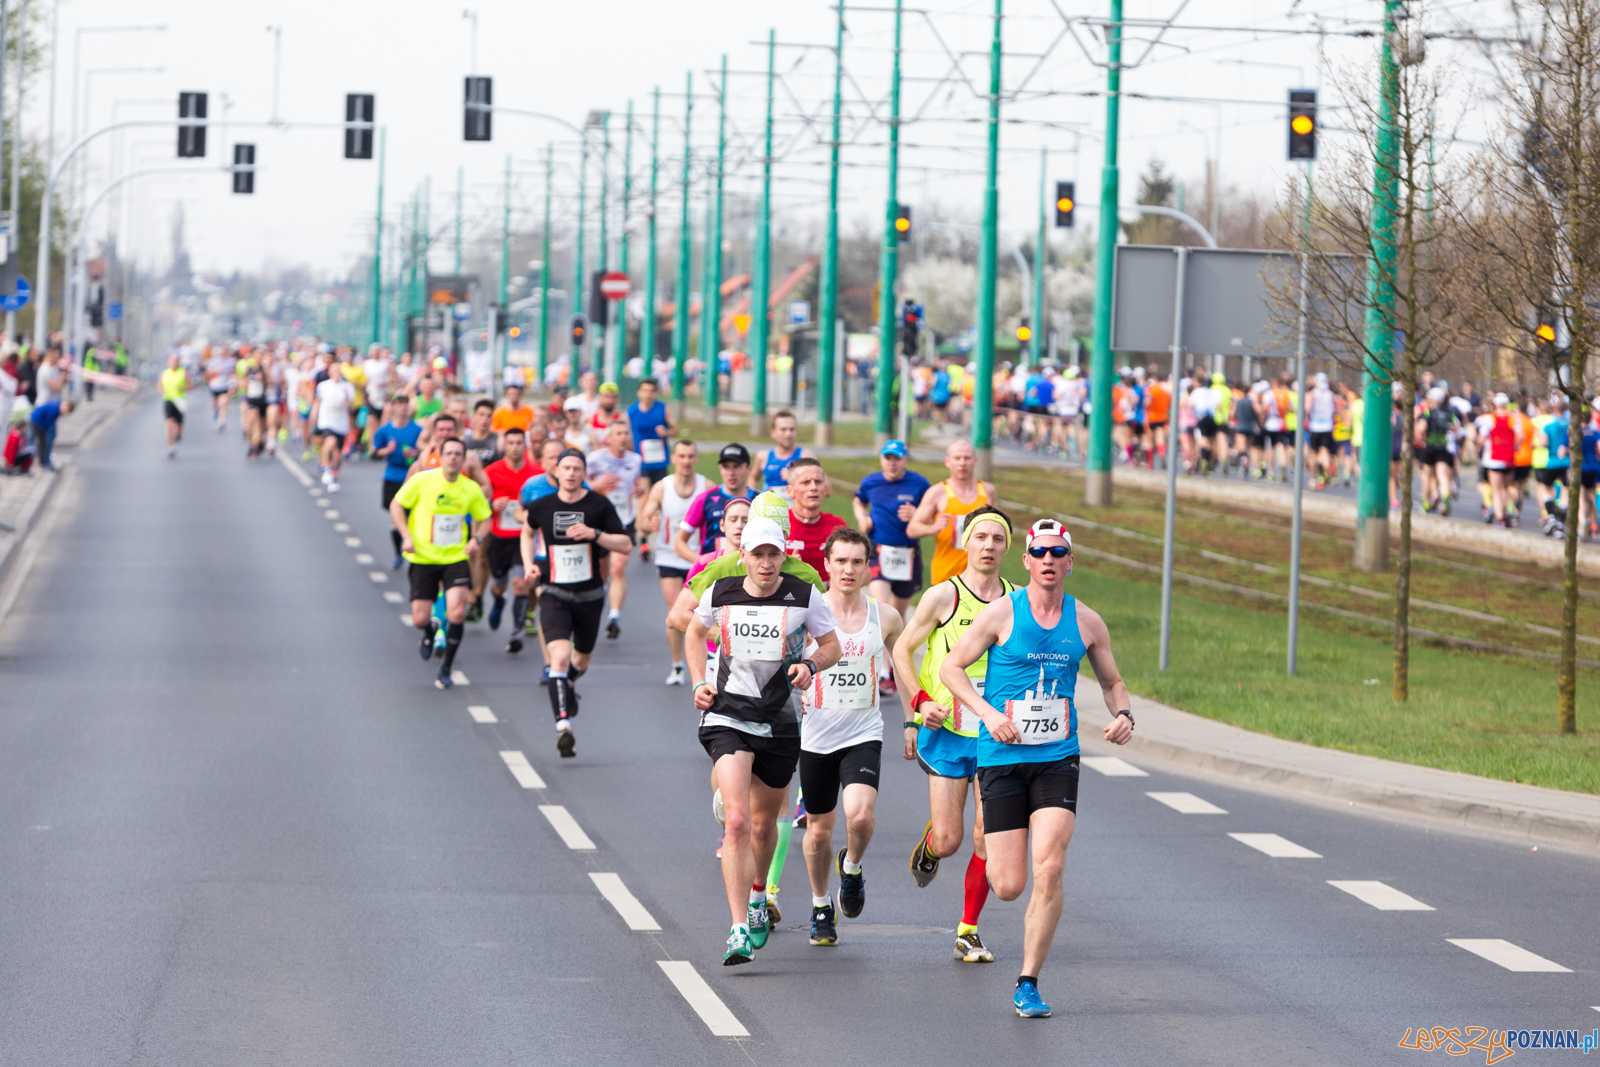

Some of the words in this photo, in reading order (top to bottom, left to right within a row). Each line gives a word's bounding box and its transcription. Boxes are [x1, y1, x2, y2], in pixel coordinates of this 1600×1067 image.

[562, 556, 583, 566] 1719
[732, 623, 780, 638] 10526
[1027, 653, 1070, 661] PIĄTKOWO
[828, 672, 867, 687] 7520
[1022, 717, 1059, 733] 7736
